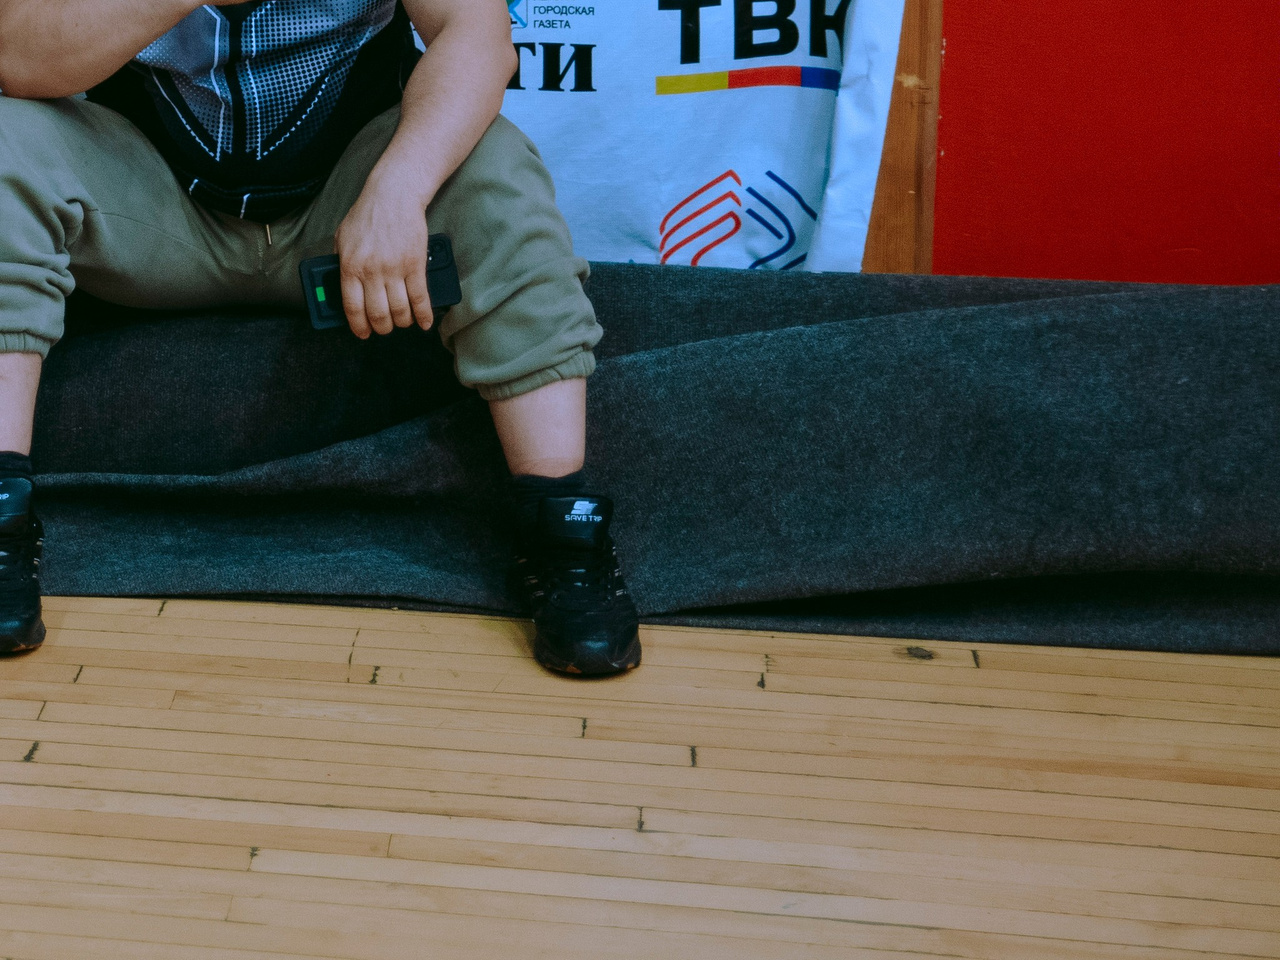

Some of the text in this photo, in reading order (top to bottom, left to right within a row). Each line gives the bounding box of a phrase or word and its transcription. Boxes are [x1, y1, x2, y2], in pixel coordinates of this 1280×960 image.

[533, 5, 595, 16] ГОРОДСКАЯ
[533, 19, 571, 29] ГАЗЕТА
[564, 514, 588, 522] SAVE
